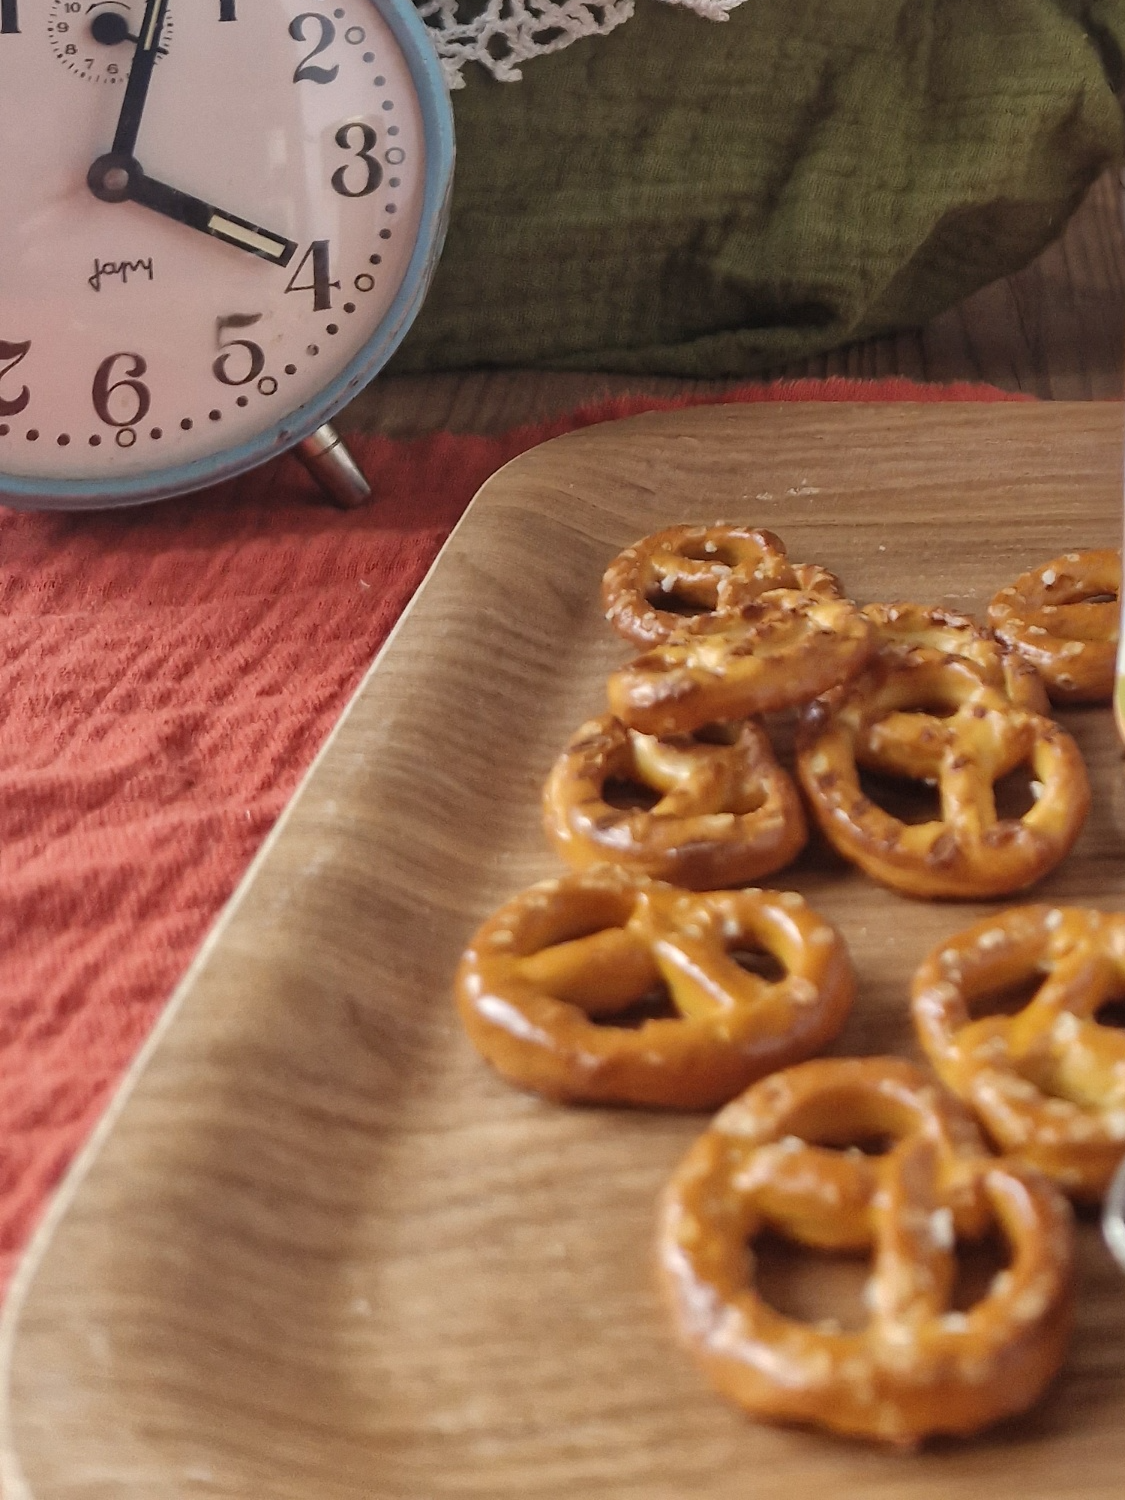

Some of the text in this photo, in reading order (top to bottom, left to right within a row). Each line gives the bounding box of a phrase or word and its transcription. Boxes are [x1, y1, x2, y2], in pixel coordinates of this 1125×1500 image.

[56, 22, 69, 32] 9
[64, 2, 81, 13] 10
[65, 44, 77, 54] 8
[84, 59, 95, 69] 7
[288, 12, 339, 84] 2
[106, 64, 118, 74] 6
[331, 123, 383, 197] 3
[285, 240, 340, 311] 4
[212, 313, 265, 385] 5
[92, 352, 151, 427] 6
